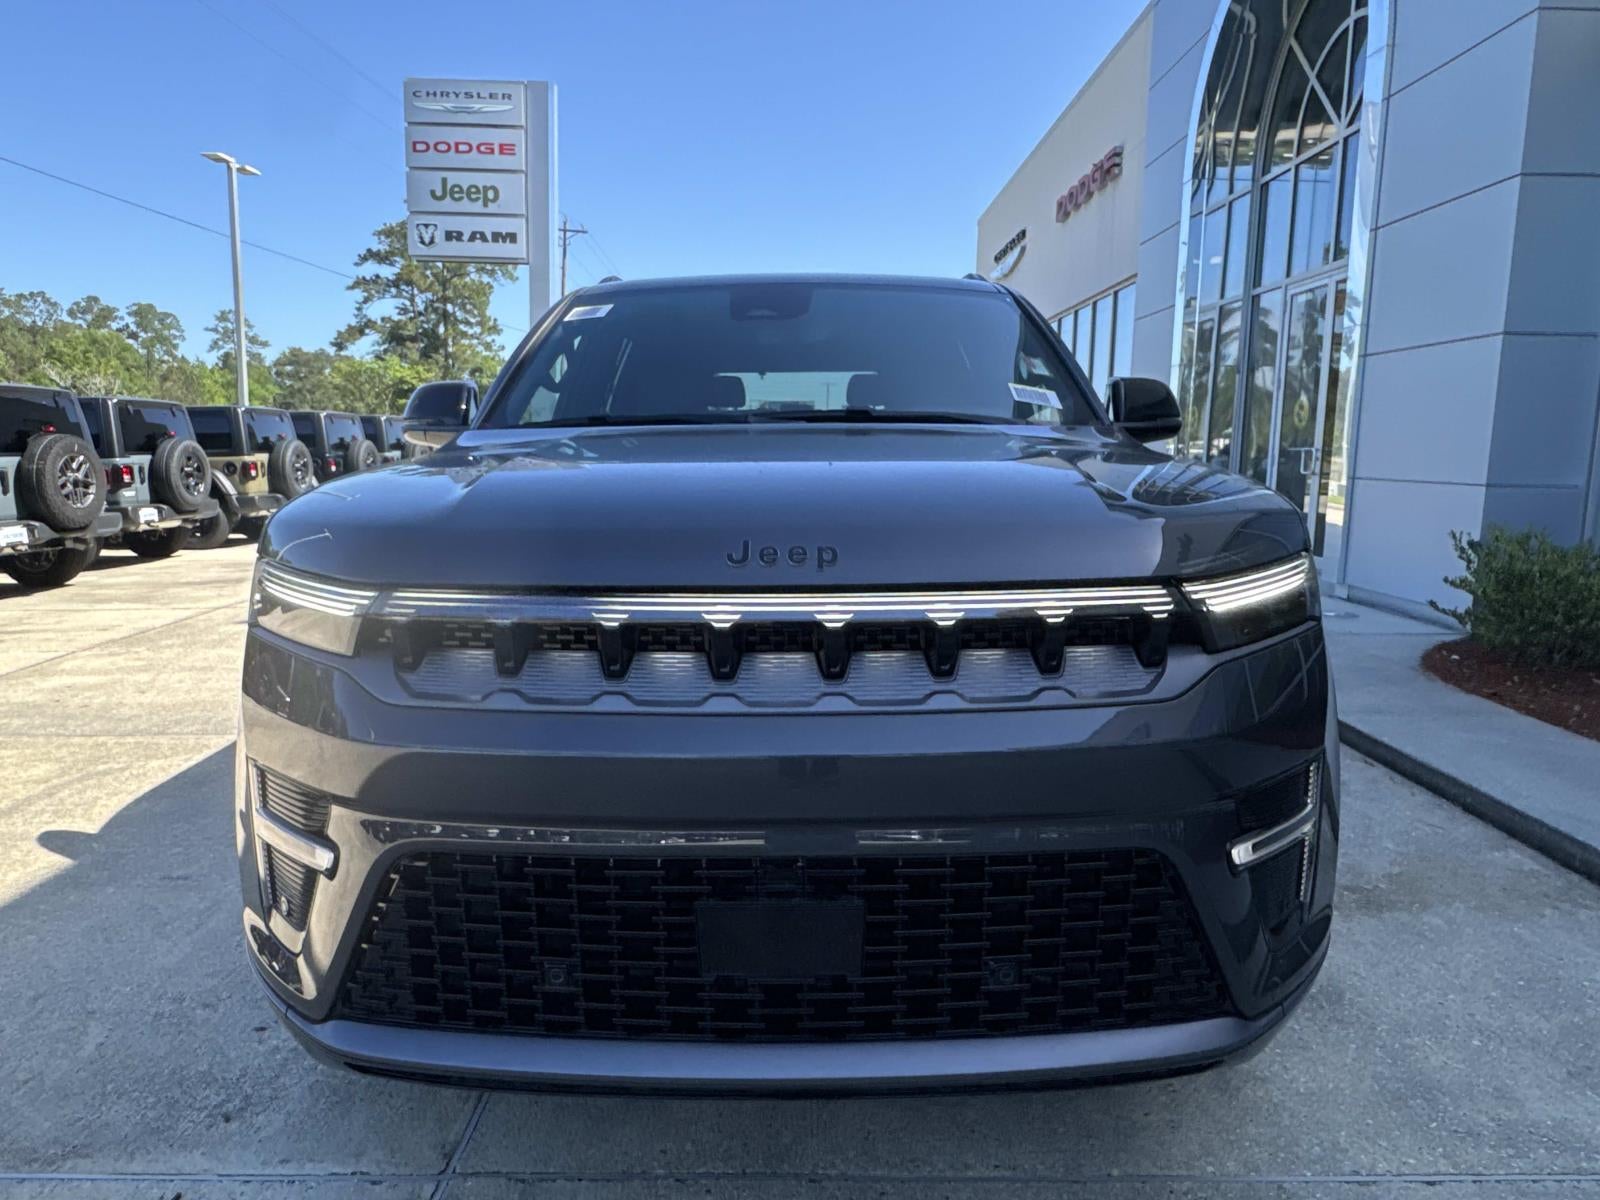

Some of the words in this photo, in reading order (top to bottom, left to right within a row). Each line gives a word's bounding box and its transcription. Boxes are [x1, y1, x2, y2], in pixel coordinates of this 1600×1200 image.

[412, 90, 513, 101] CHRYSLER
[412, 140, 517, 156] DODGE
[429, 176, 501, 208] Jeep
[1055, 144, 1124, 223] DODGE
[444, 229, 518, 245] RAM
[726, 539, 839, 571] Jeep
